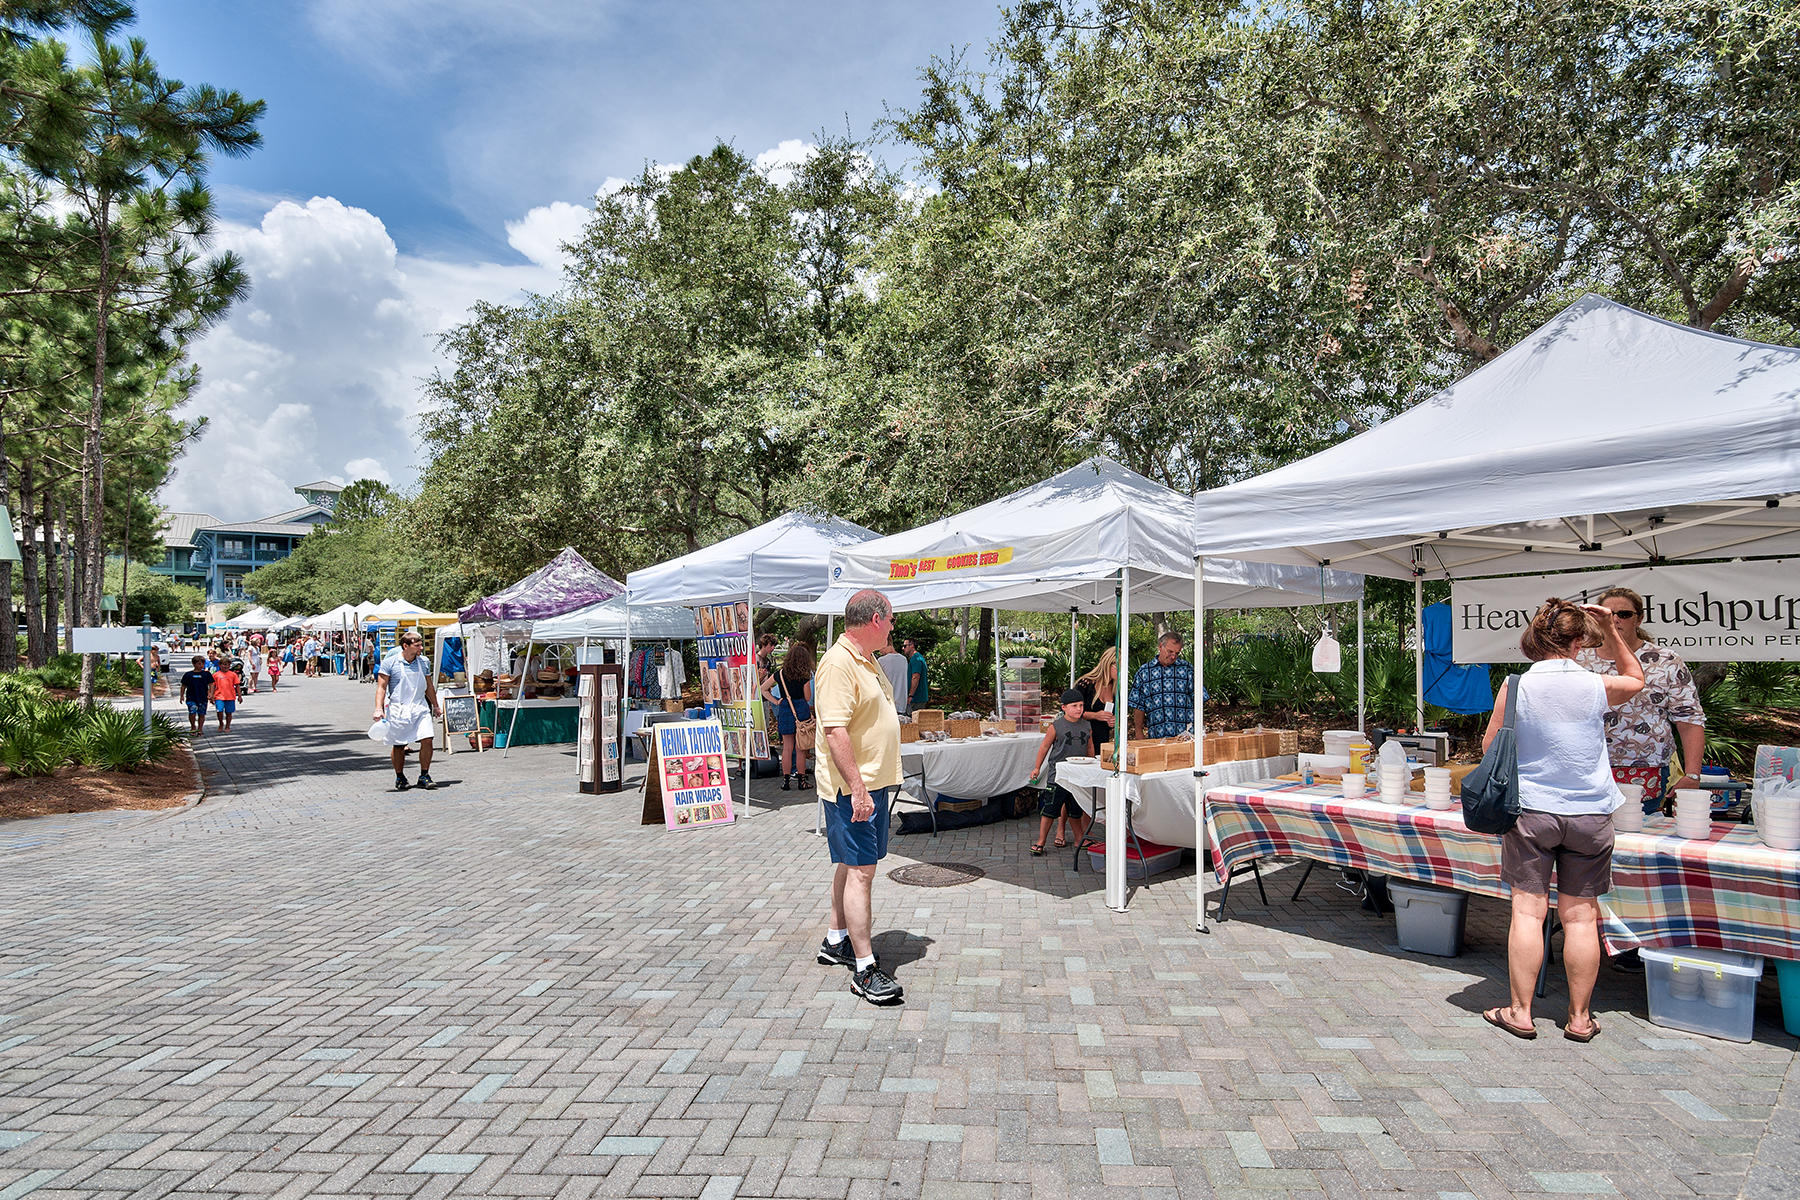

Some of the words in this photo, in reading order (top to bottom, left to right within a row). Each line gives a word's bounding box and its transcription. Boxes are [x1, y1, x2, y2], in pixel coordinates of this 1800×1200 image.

[889, 562, 917, 578] Tina's
[918, 560, 936, 571] BEST
[946, 554, 978, 569] COOKIES
[979, 552, 999, 565] EVER
[716, 636, 748, 657] TATTOO
[660, 727, 689, 756] HENNA
[688, 725, 721, 754] TATTOOS
[675, 791, 694, 806] HAIR
[695, 788, 722, 804] WRAPS
